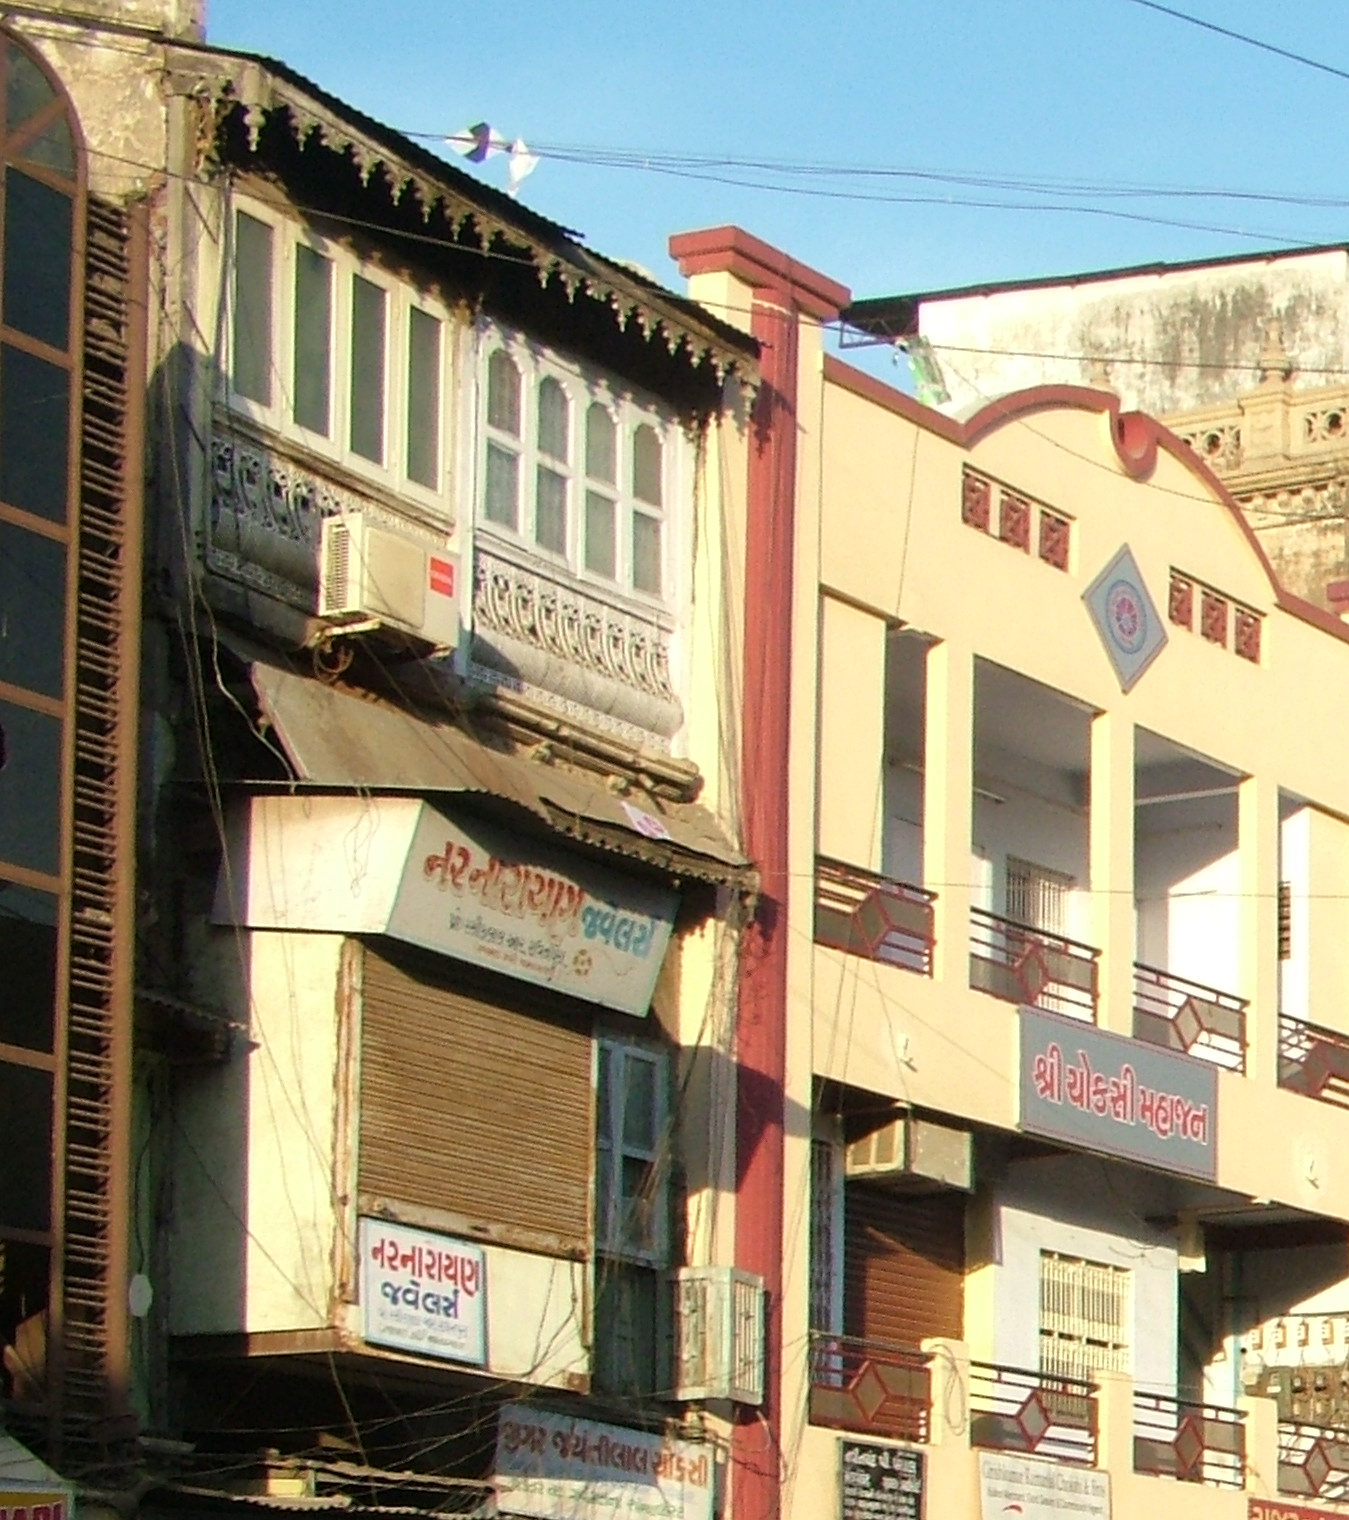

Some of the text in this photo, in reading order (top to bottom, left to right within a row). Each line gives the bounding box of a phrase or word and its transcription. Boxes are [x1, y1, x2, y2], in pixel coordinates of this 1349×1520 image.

[1034, 1042, 1208, 1146] શ્રી ચોકસી મહાજન
[371, 1238, 479, 1297] નરનારાયણ
